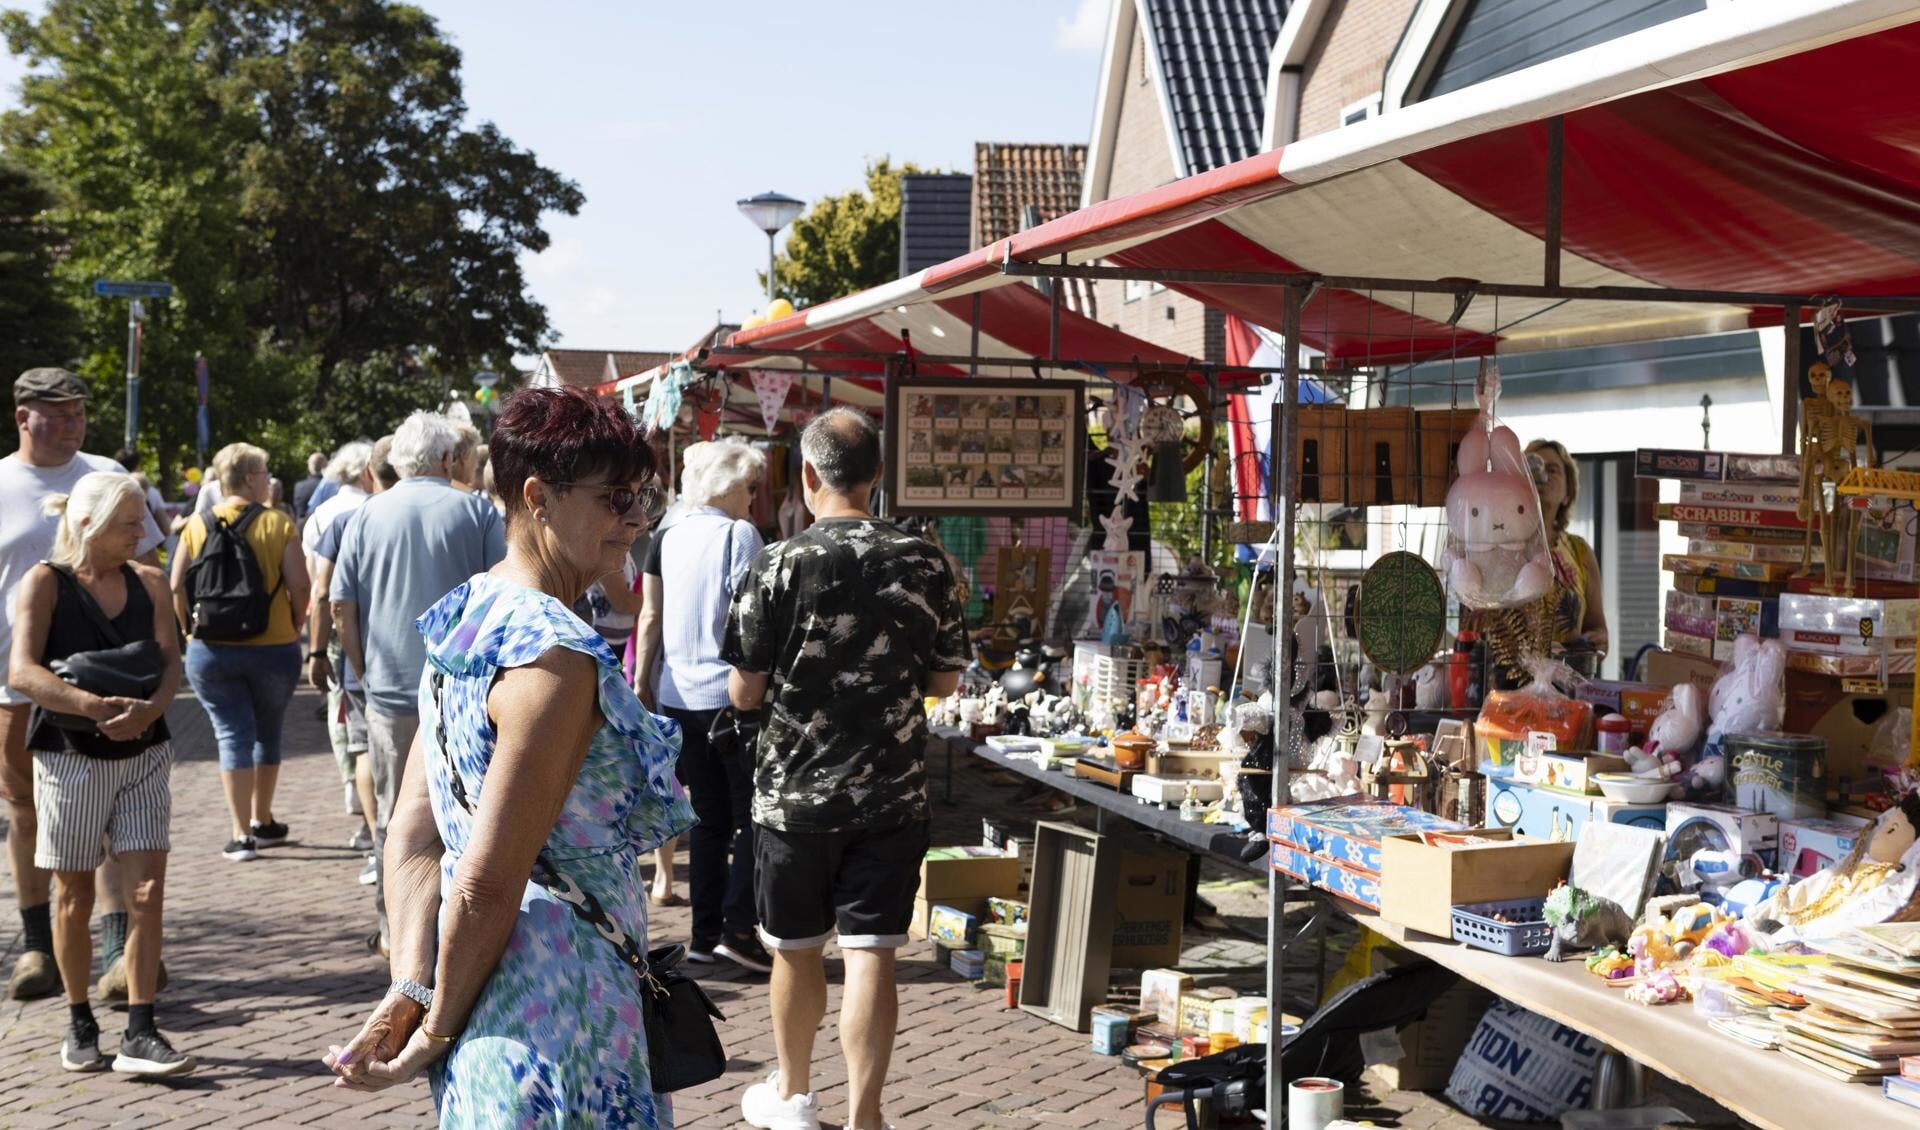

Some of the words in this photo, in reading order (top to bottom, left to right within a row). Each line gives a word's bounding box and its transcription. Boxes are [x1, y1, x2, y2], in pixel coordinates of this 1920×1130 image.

[1673, 505, 1761, 525] SCRABBLE
[1798, 634, 1838, 645] MONOPOLY
[1732, 752, 1784, 773] CASTLE
[1471, 1021, 1532, 1077] TION
